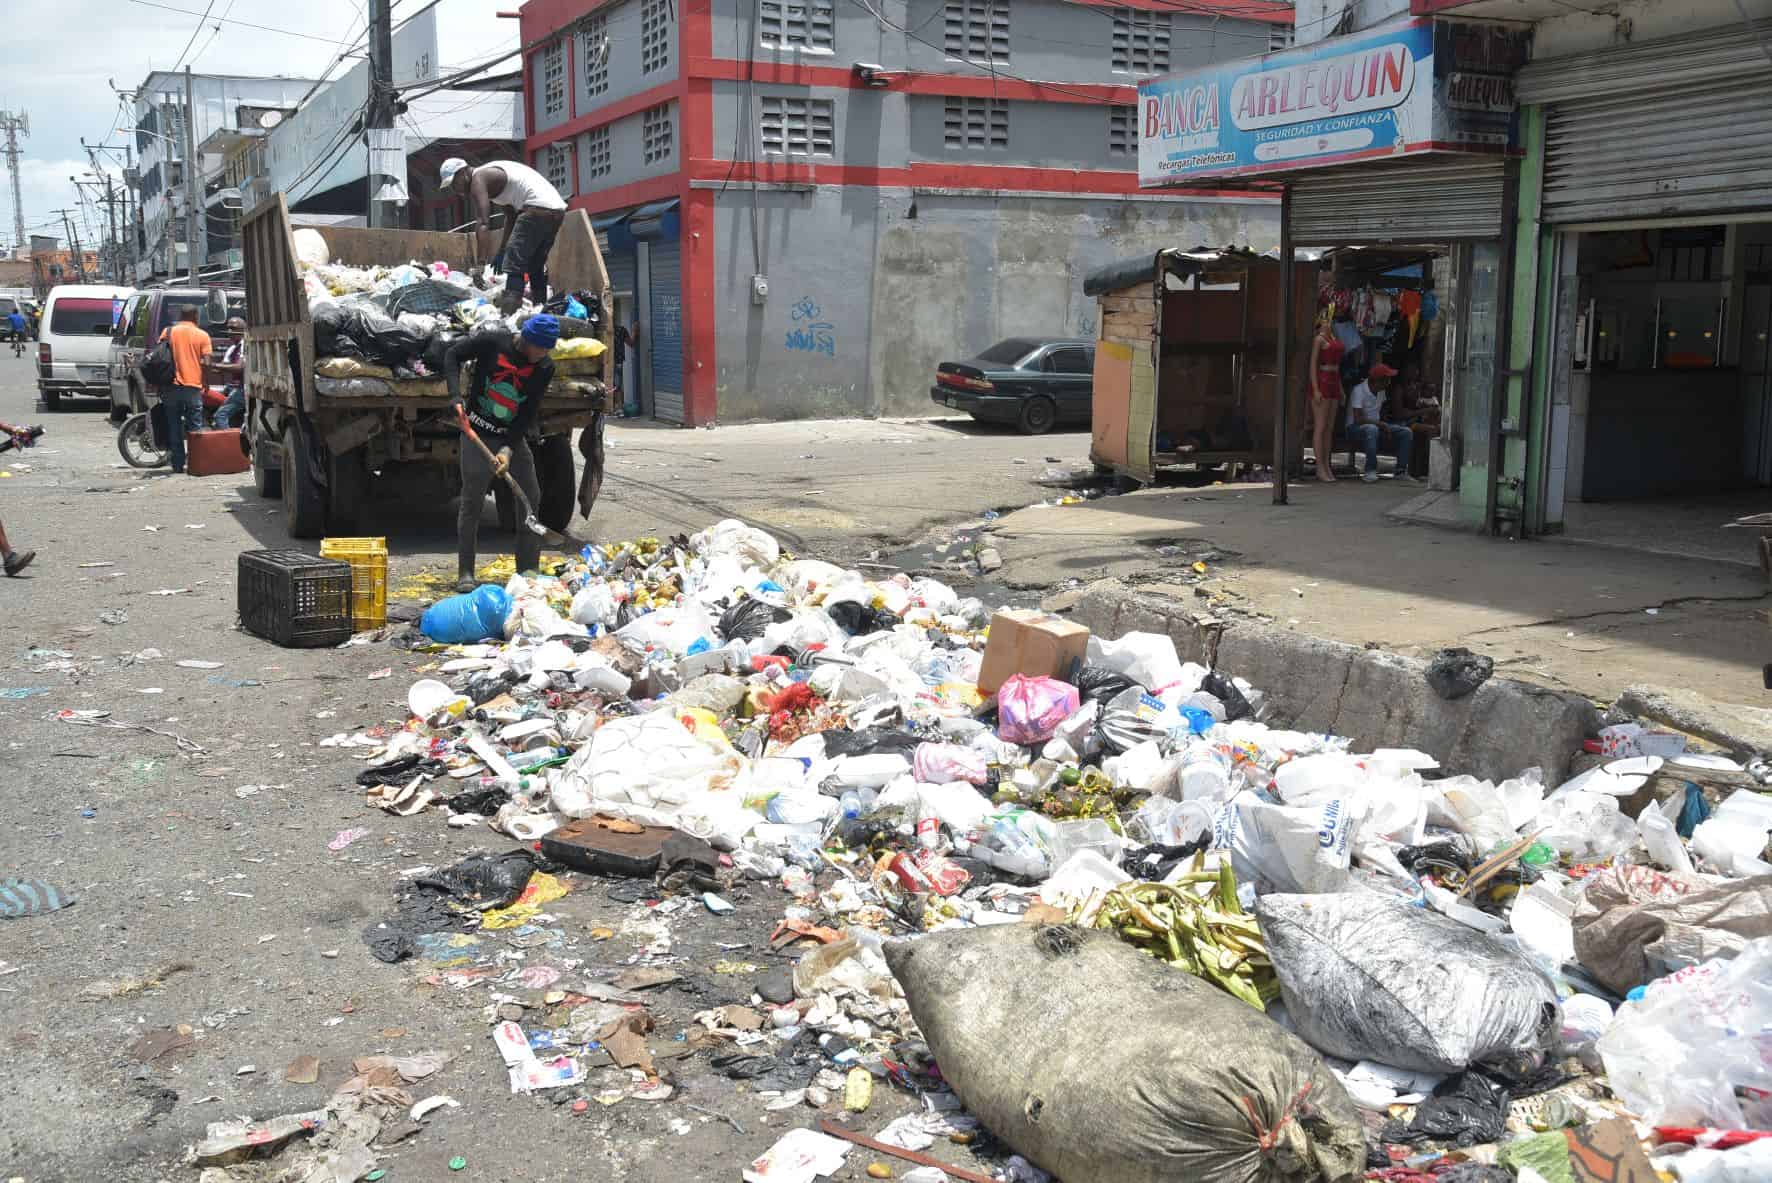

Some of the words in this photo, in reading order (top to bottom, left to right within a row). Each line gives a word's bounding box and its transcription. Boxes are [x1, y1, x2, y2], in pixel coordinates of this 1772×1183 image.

[1144, 84, 1219, 139] BANCA
[1236, 47, 1407, 120] ARLEQUIN
[1255, 125, 1315, 142] SEGURIDAD
[1324, 111, 1392, 131] CONFIANZA
